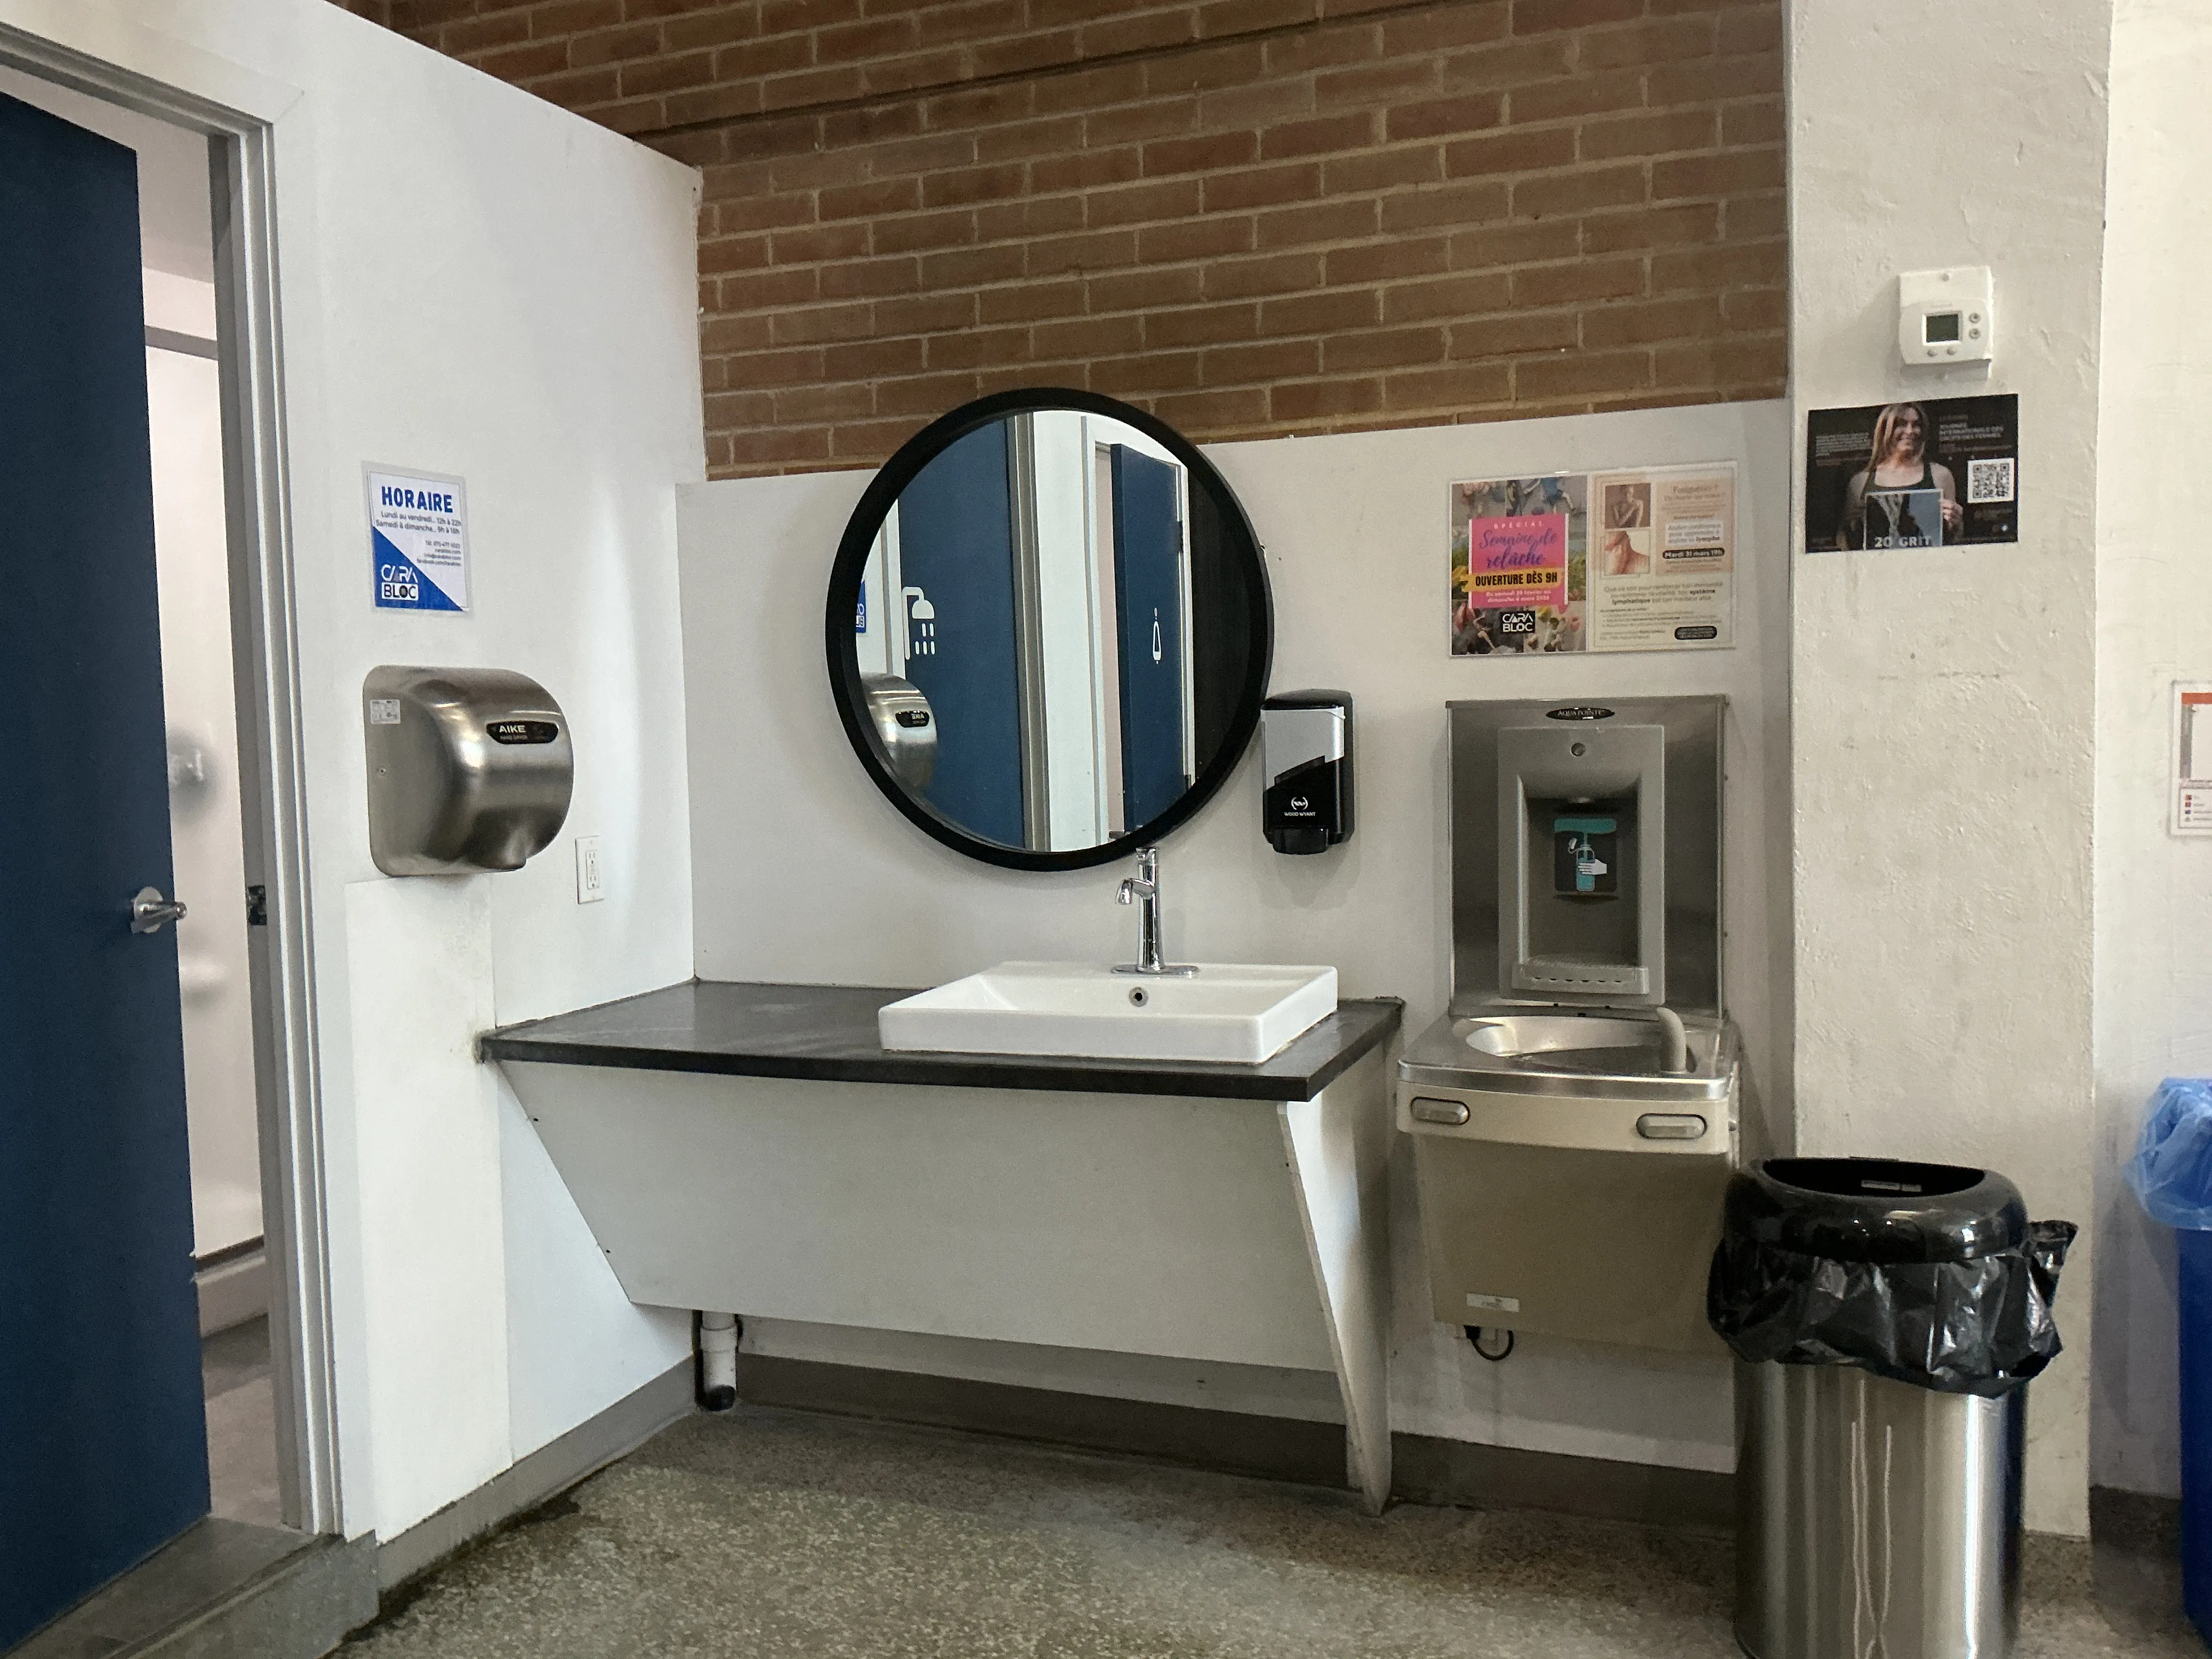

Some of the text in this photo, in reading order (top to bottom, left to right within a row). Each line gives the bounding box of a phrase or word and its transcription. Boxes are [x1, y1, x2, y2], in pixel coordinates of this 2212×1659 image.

[381, 486, 453, 513] HORAIRE
[1874, 535, 1932, 548] 20 GRIT
[381, 564, 418, 582] CARA
[1475, 571, 1558, 586] OUVERTURE DÈS 9H
[384, 583, 417, 599] BLOC
[1502, 613, 1534, 623] CARA
[1503, 622, 1534, 633] BLOC
[499, 725, 526, 733] AIKE
